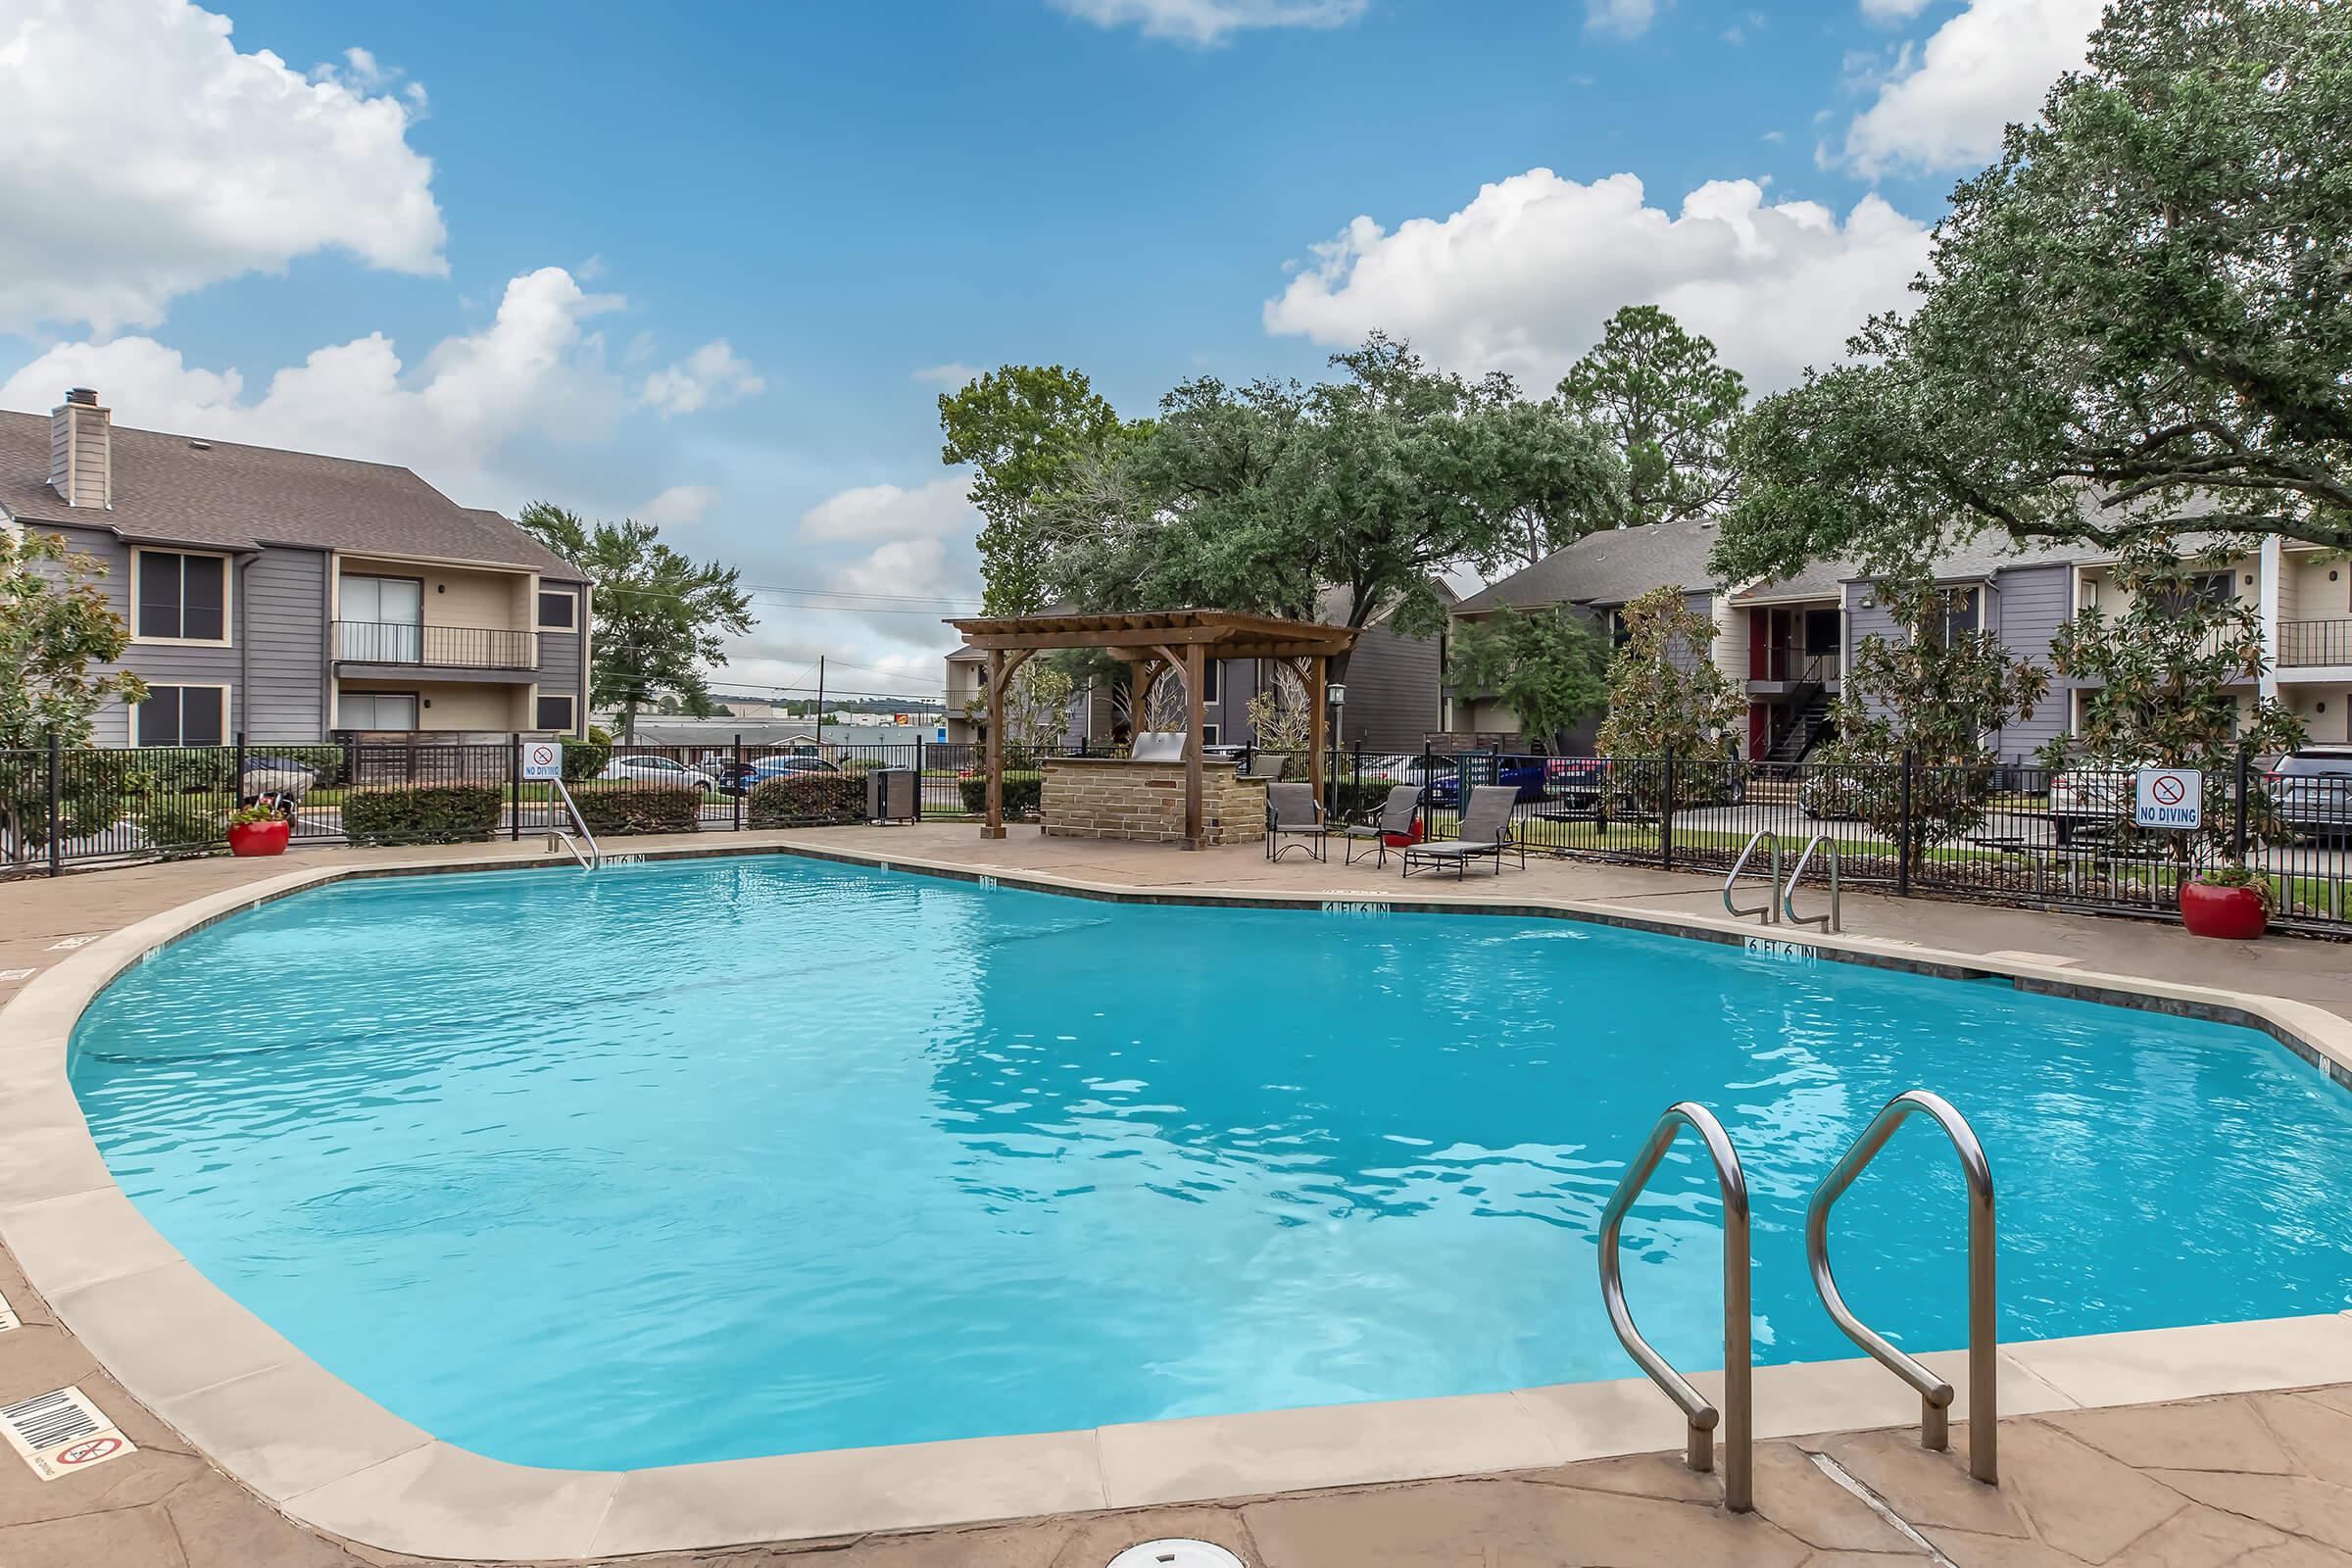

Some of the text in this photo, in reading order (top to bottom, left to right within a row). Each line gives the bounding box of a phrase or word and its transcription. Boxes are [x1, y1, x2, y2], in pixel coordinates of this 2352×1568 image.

[537, 766, 559, 776] DIVING
[2140, 807, 2196, 823] NO DIVING
[1749, 939, 1814, 957] 6 FT 6 IN
[13, 1403, 100, 1450] DIVING
